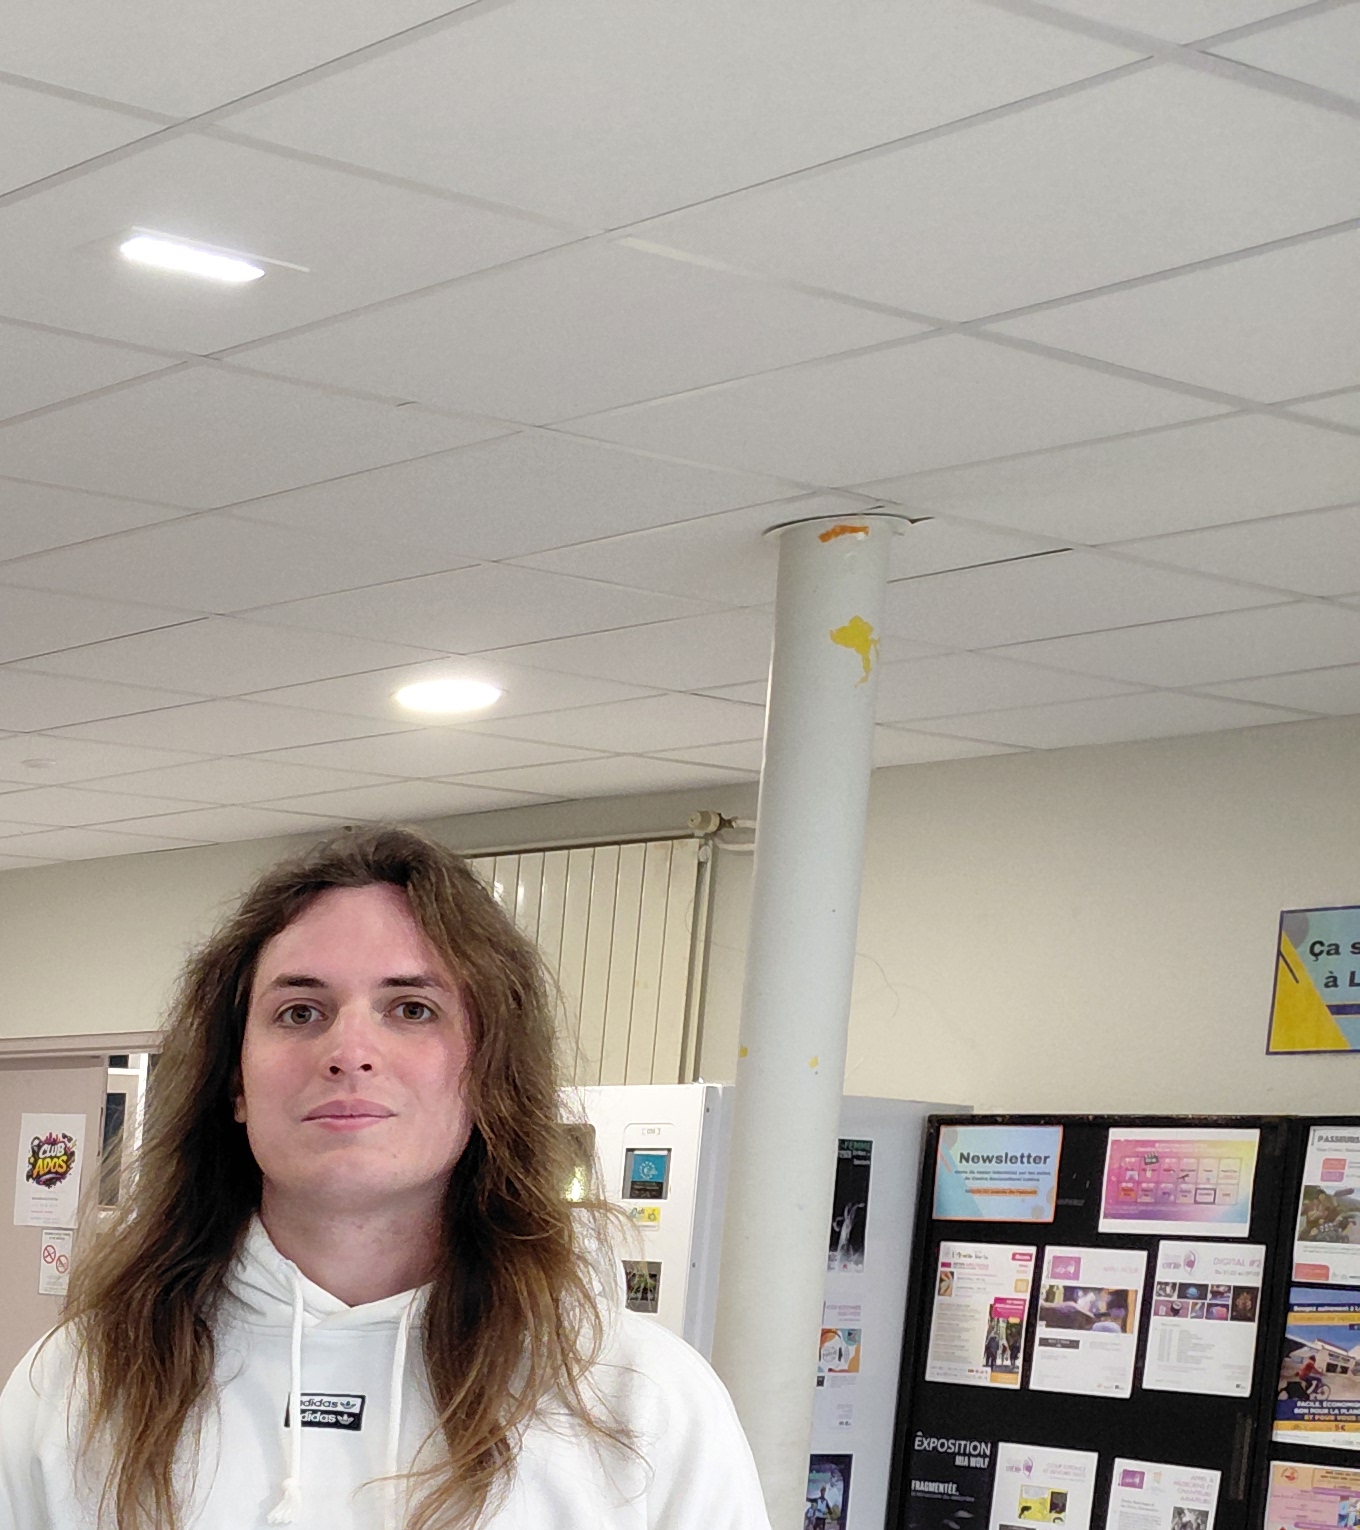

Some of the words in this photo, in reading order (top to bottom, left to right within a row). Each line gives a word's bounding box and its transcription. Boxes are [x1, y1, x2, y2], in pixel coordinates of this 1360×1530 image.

[1308, 940, 1341, 962] Ça
[1323, 971, 1339, 989] à
[39, 1143, 65, 1158] CLUB
[959, 1151, 1050, 1165] Newsletter
[33, 1155, 68, 1178] ADOS
[300, 1411, 337, 1423] didas
